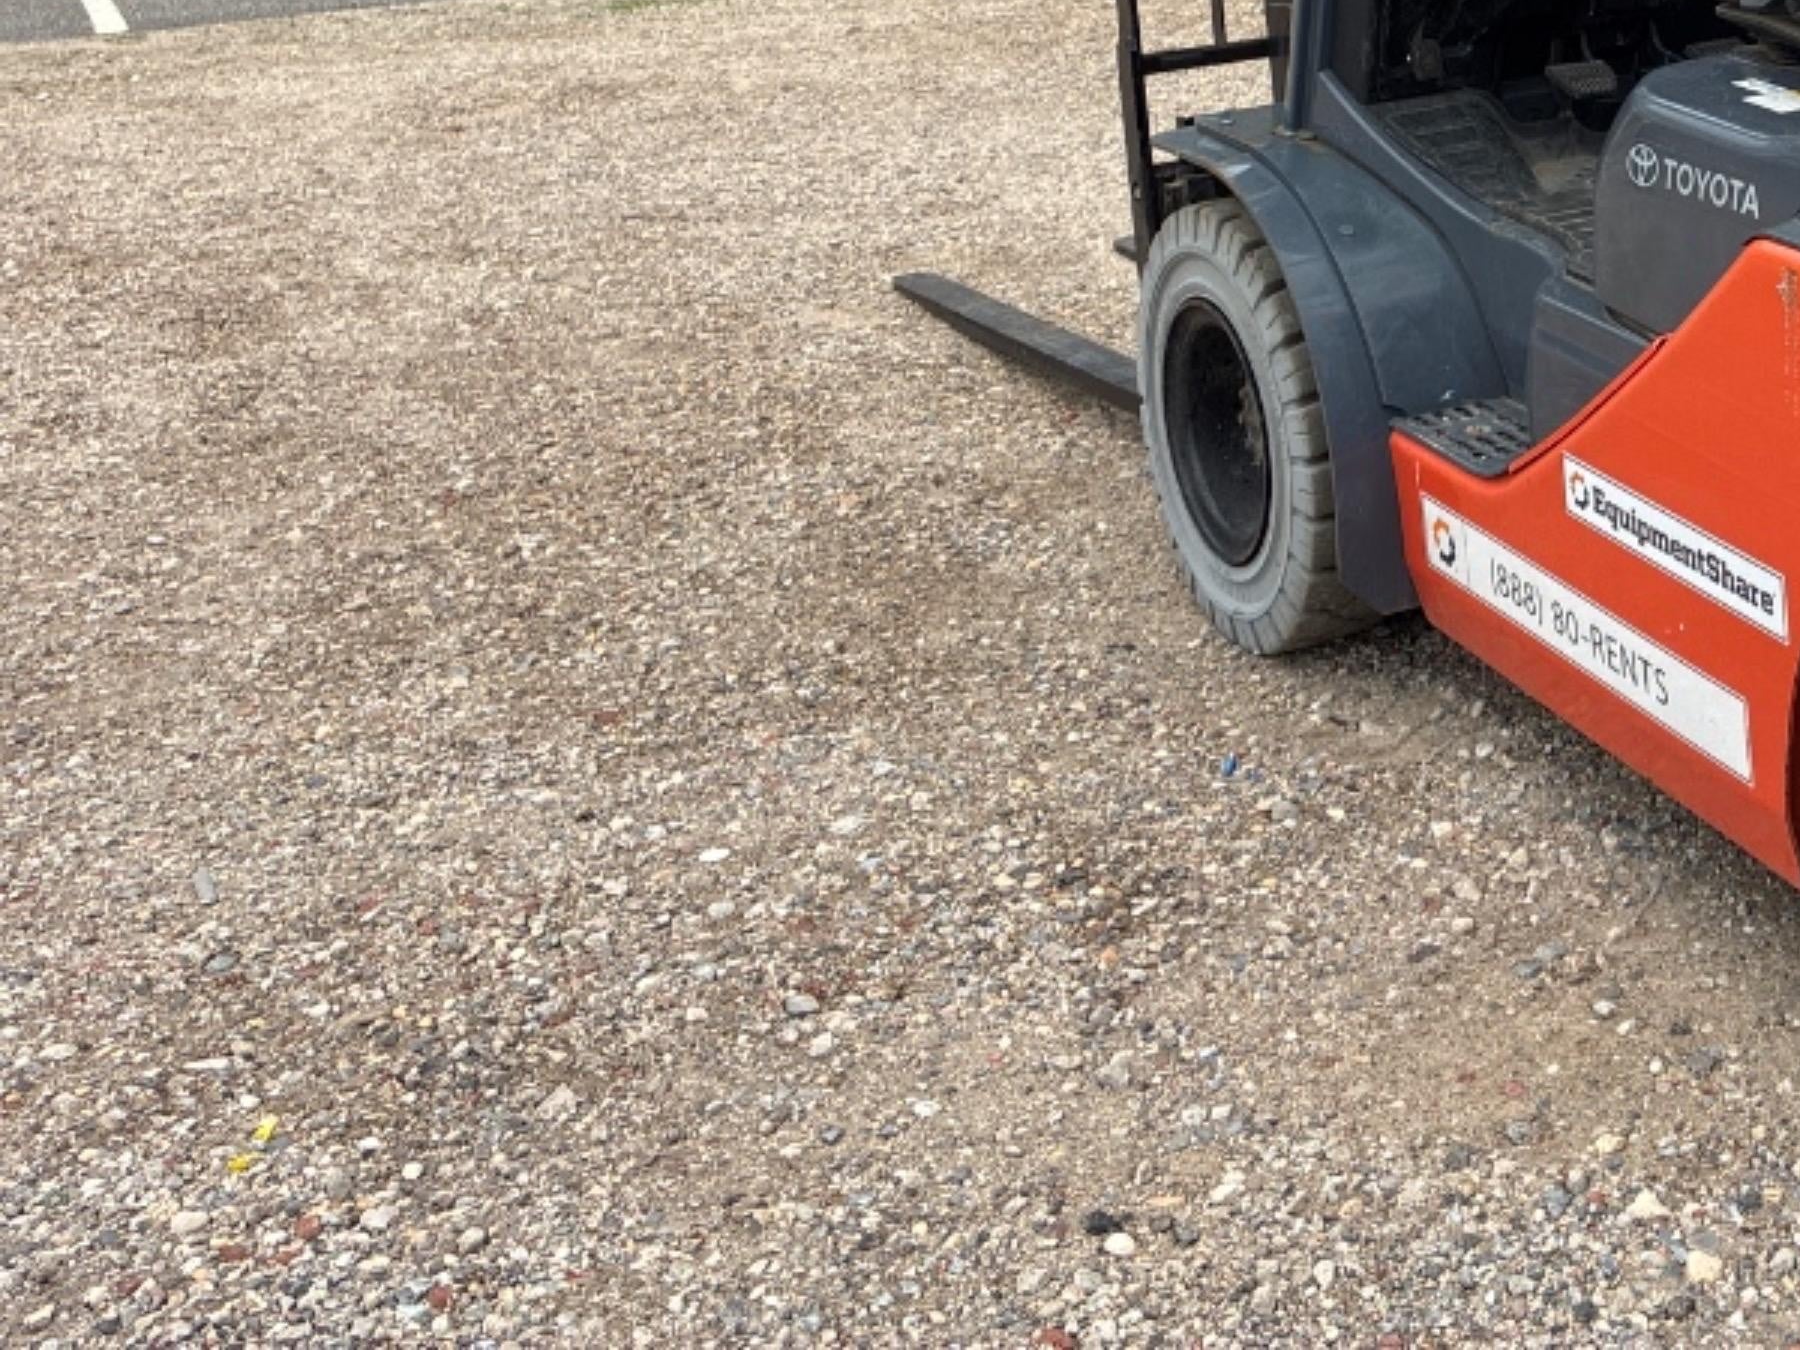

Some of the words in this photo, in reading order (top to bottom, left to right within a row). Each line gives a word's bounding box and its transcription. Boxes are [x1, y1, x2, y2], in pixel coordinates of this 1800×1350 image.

[1662, 158, 1760, 219] TOYOTA
[1592, 488, 1776, 615] EquipmentShare
[1489, 559, 1544, 626] (888)
[1550, 601, 1671, 706] 80-RENTS
